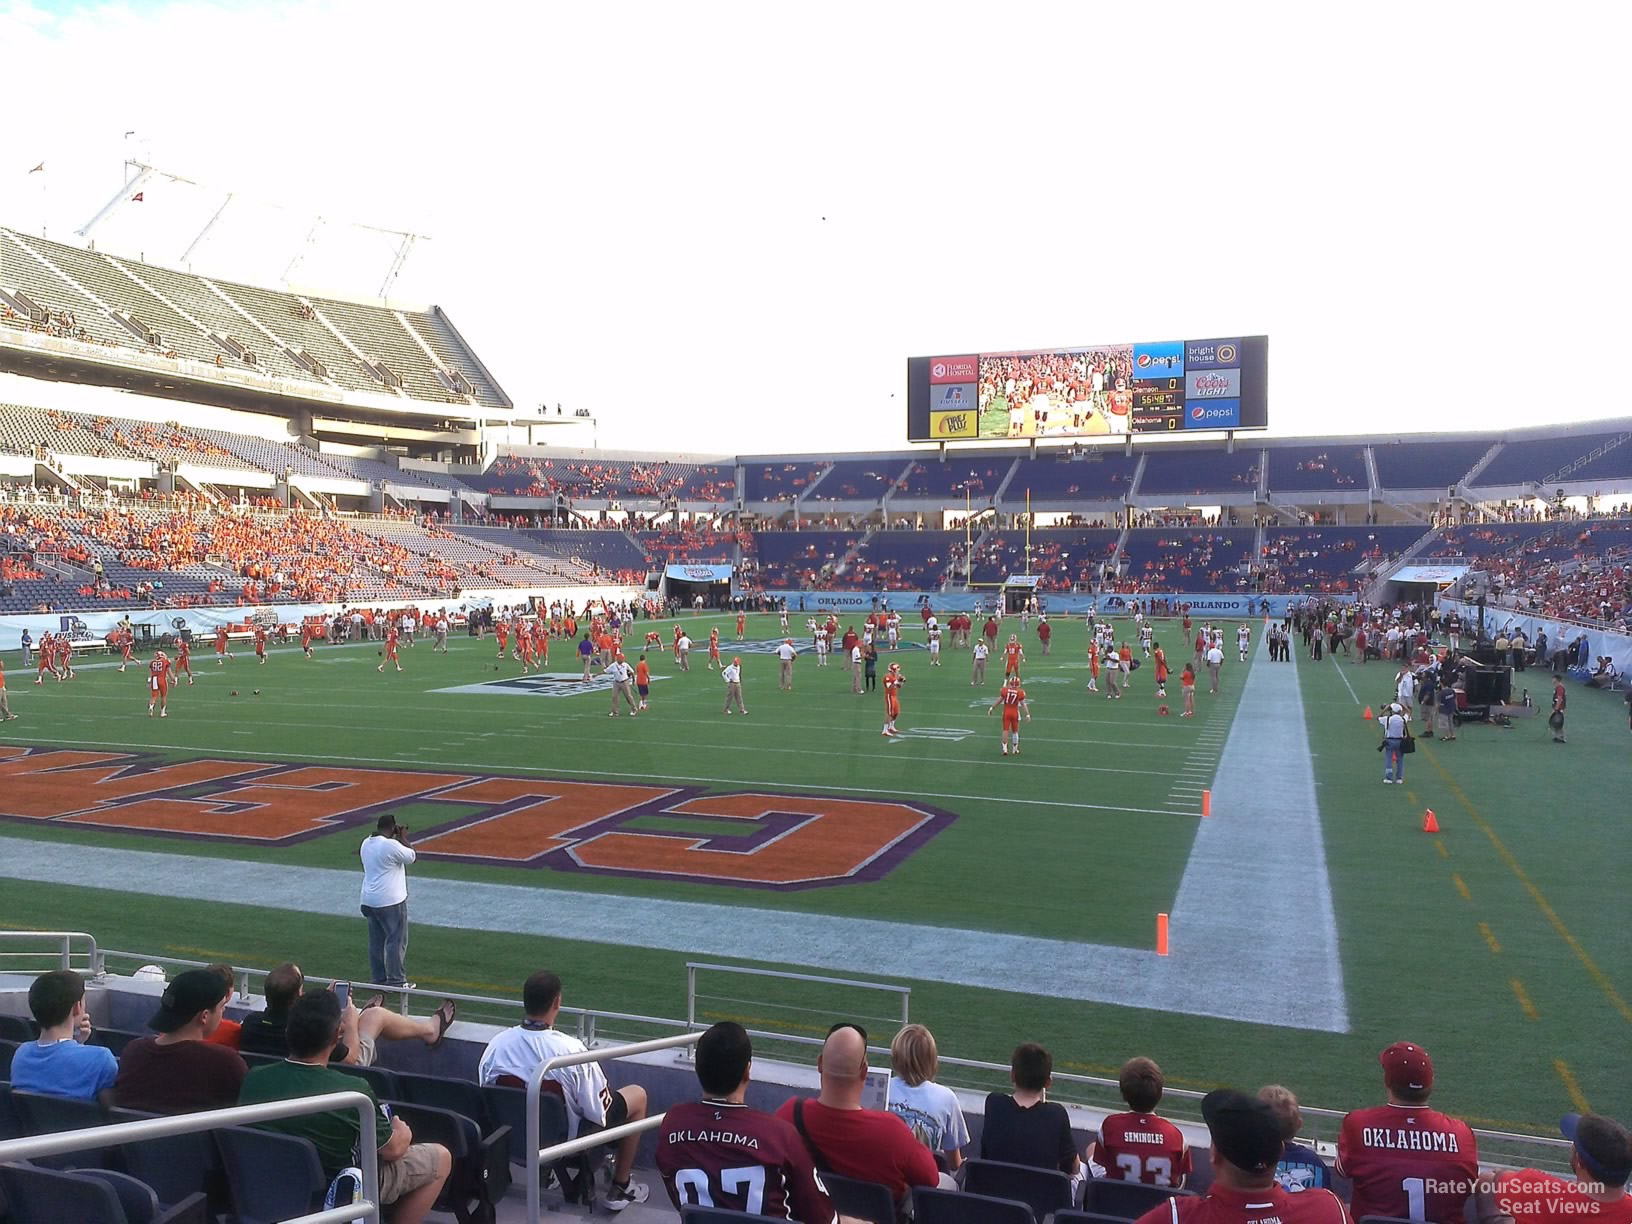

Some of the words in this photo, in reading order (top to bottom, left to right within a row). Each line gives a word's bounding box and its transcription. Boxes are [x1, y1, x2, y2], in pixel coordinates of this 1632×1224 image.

[1189, 346, 1214, 355] bright
[1168, 378, 1177, 389] 0
[1195, 376, 1229, 389] Coors
[1197, 388, 1227, 396] LIGHT
[1206, 407, 1233, 418] pepsi
[946, 413, 967, 424] TIRES
[1168, 418, 1176, 429] 0
[948, 420, 967, 433] PLUS
[818, 597, 863, 605] ORLANDO
[1188, 601, 1240, 609] ORLANDO
[152, 661, 163, 671] 92
[1006, 692, 1018, 704] 17
[0, 746, 956, 890] CLEM
[668, 1130, 759, 1150] OKLAHOMA
[1124, 1131, 1164, 1145] SEMINOLES
[1363, 1127, 1459, 1153] OKLAHOMA
